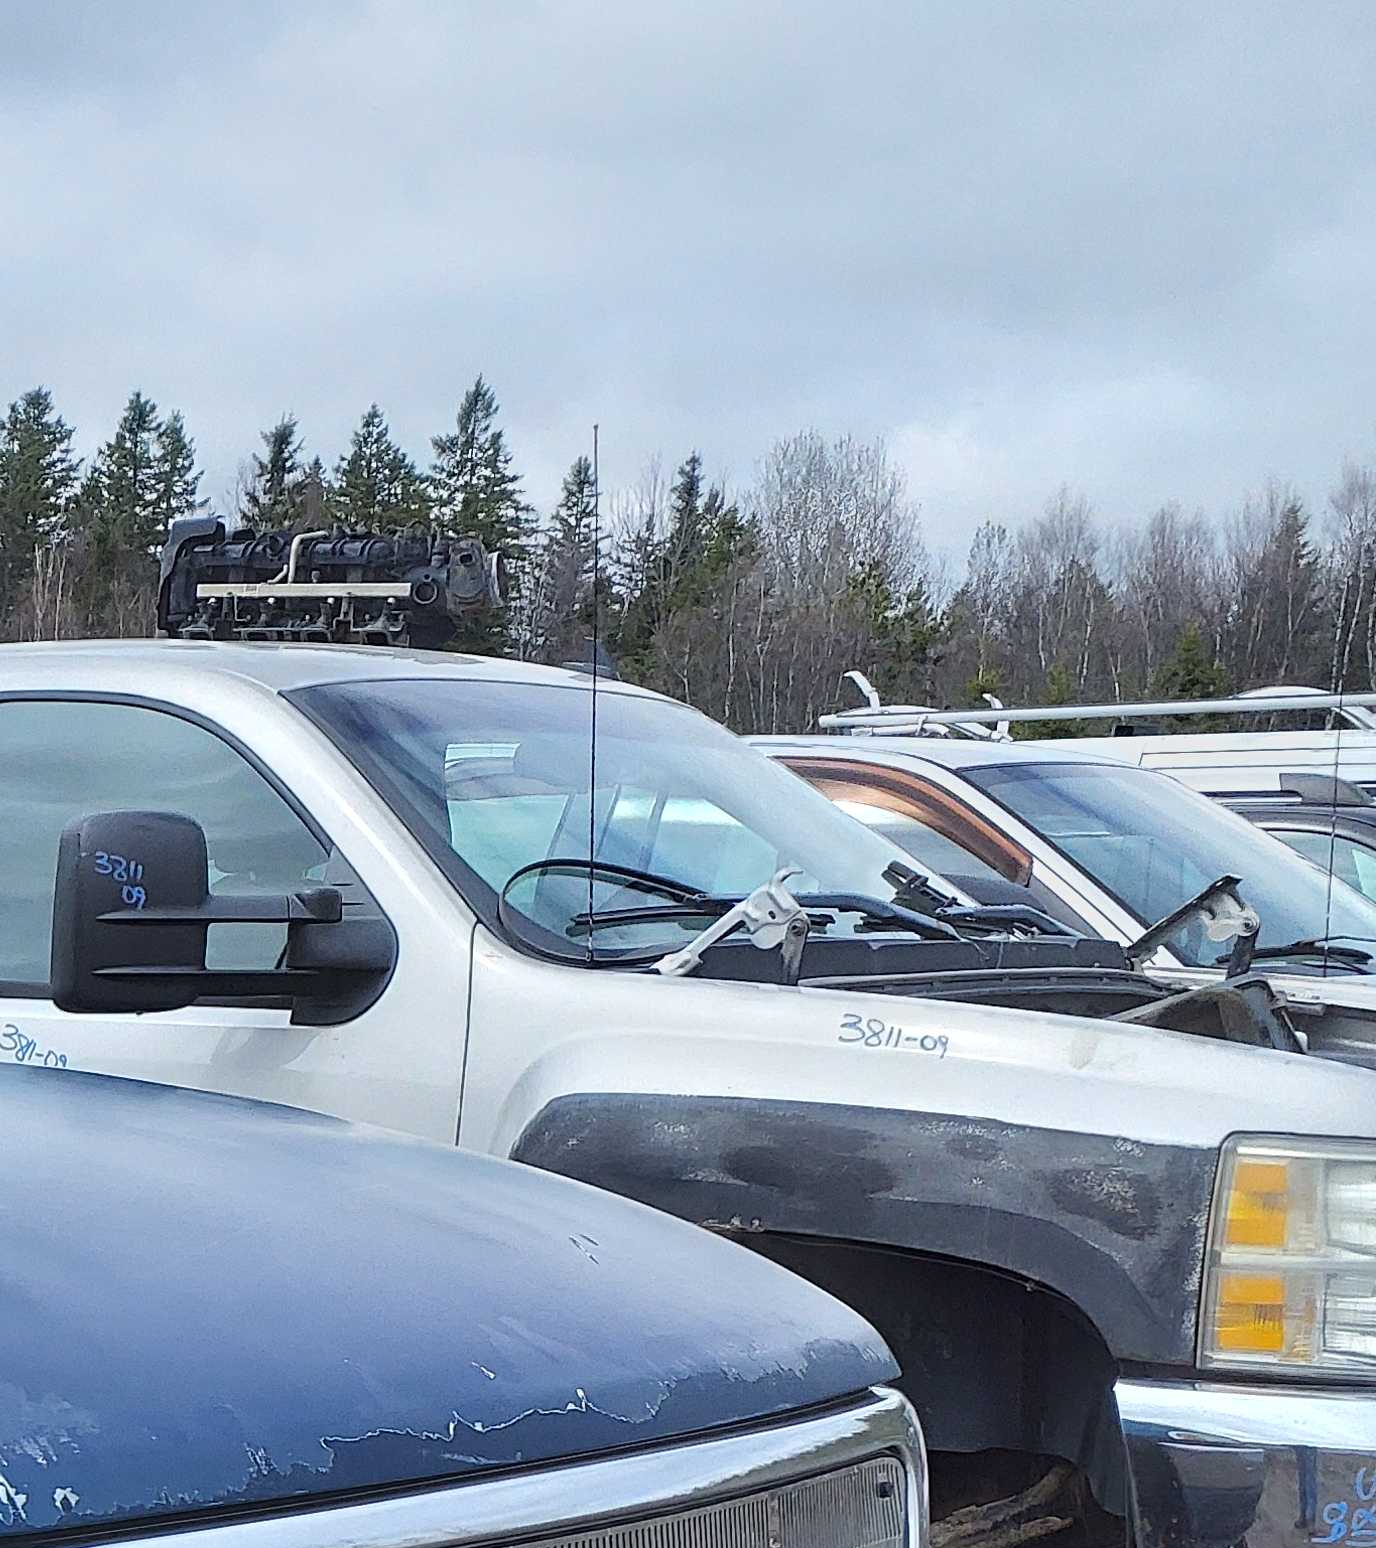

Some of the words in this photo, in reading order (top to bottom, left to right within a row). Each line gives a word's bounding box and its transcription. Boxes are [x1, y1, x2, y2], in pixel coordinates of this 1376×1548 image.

[94, 850, 143, 882] 3811
[121, 885, 146, 910] 09
[837, 1012, 949, 1059] 3811-09
